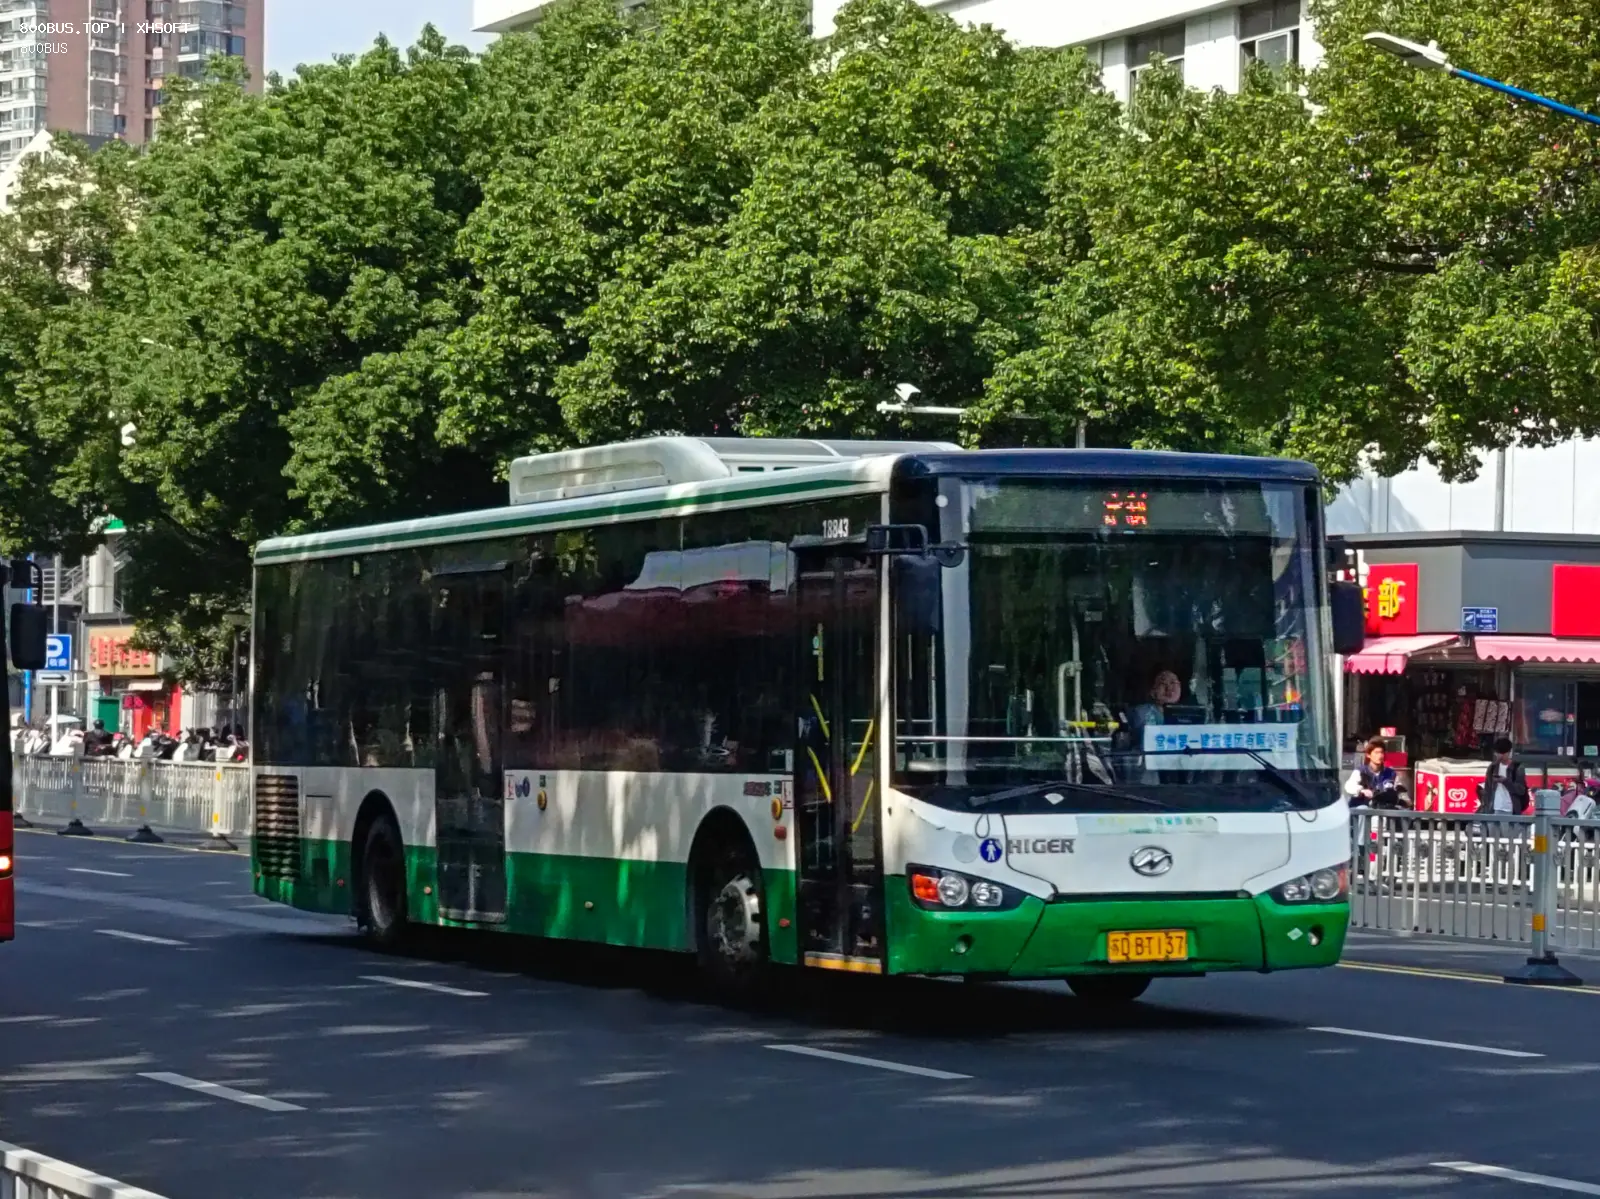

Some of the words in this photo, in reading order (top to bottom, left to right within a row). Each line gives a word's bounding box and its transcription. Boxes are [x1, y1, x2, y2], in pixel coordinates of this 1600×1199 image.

[822, 518, 849, 539] 18843
[46, 638, 64, 669] P
[1006, 838, 1076, 854] HIGER
